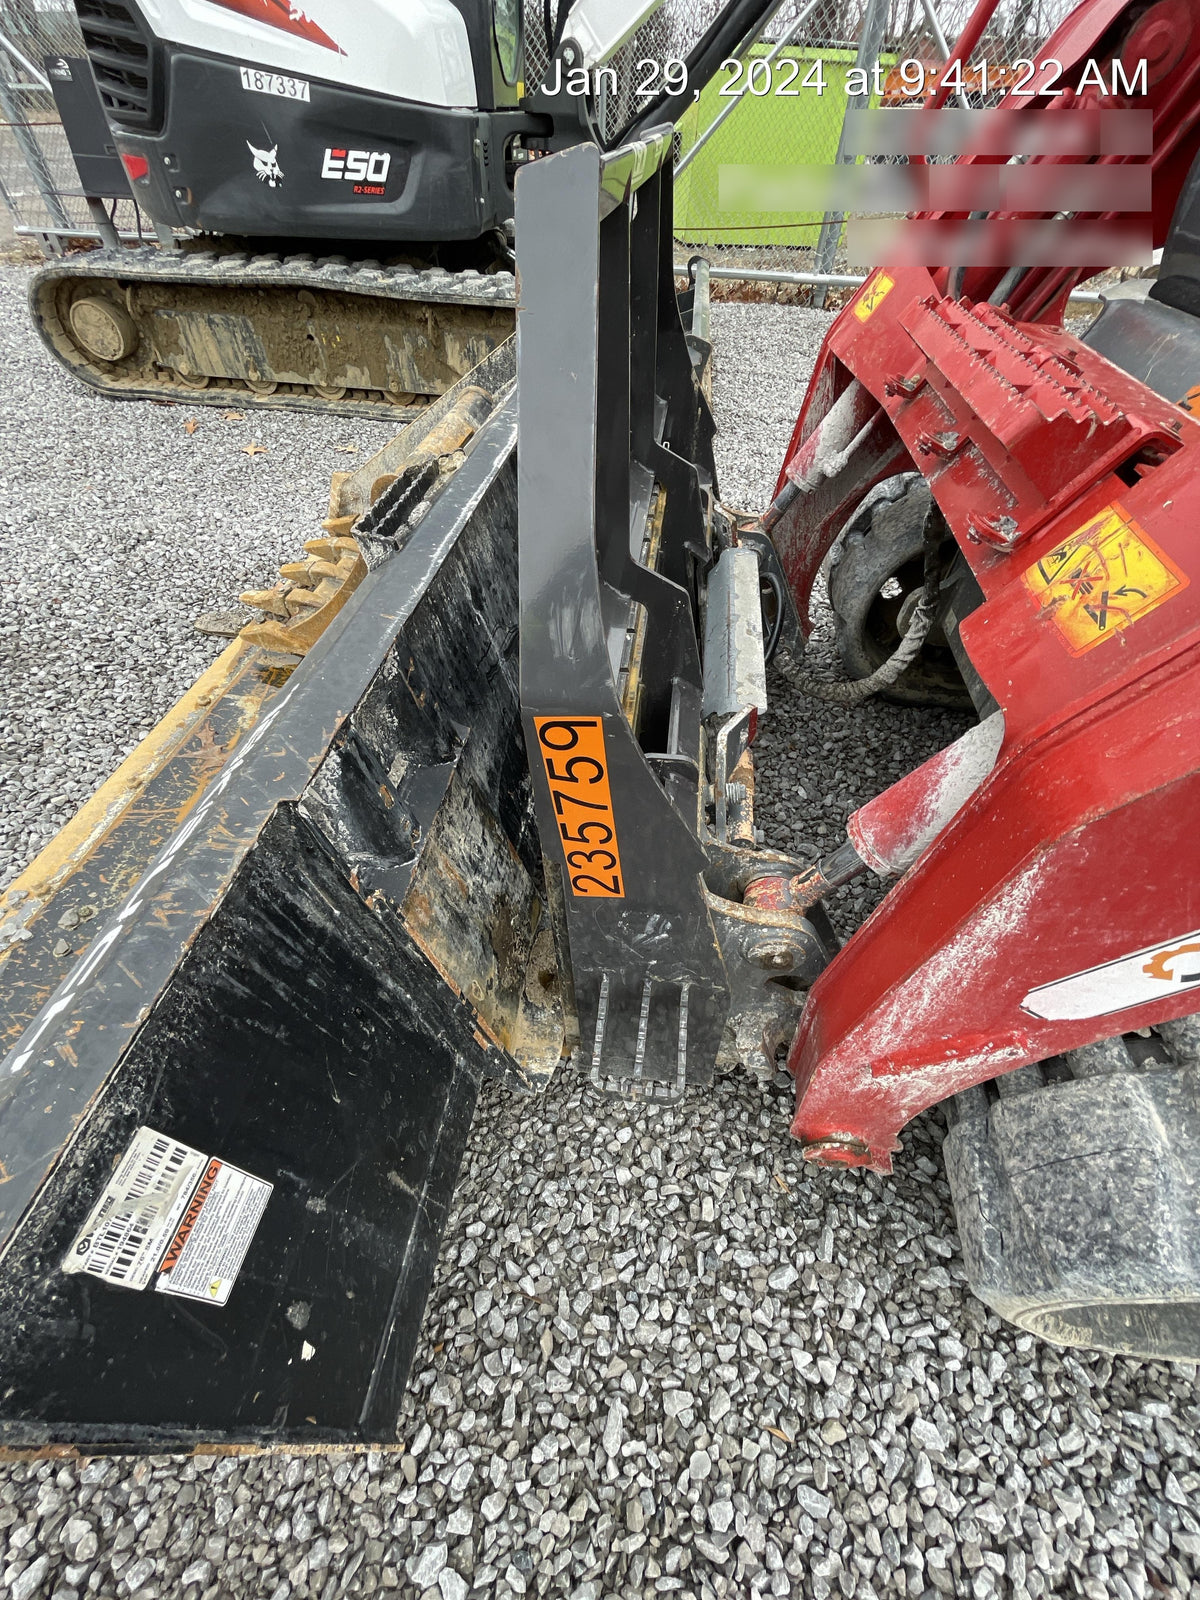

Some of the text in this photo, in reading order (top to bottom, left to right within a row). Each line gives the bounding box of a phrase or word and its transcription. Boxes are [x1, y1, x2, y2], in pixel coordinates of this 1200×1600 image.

[242, 68, 307, 99] 187337
[321, 148, 391, 183] E50
[539, 720, 621, 895] 235759
[166, 1164, 219, 1264] WARNING
